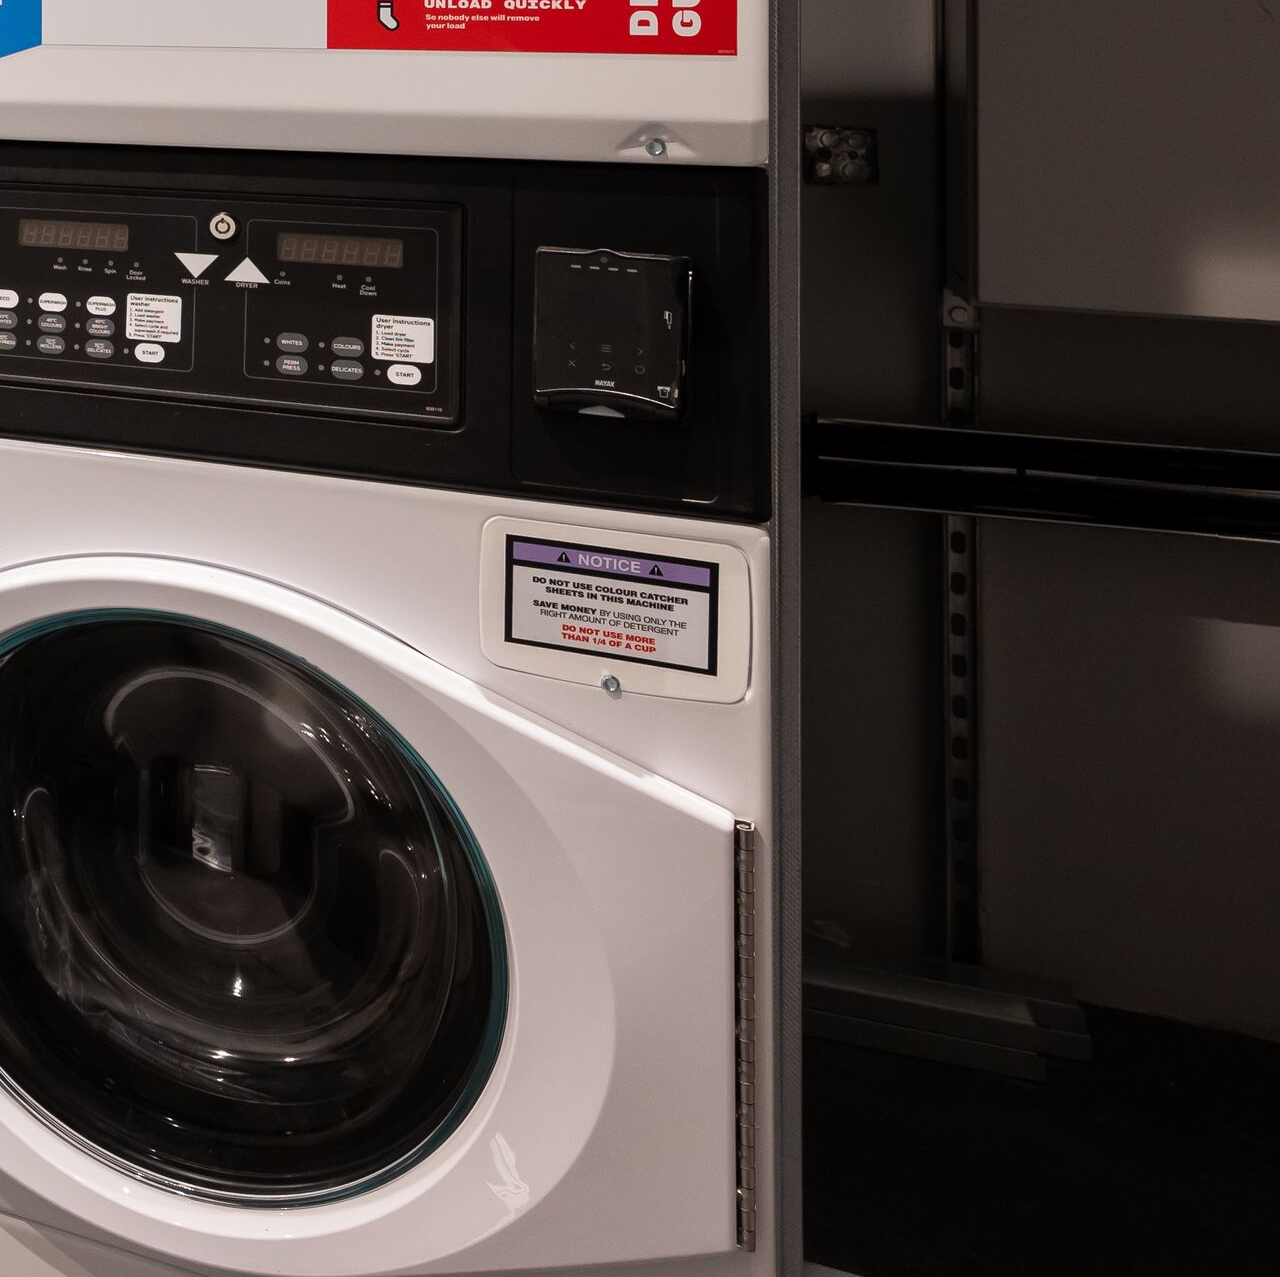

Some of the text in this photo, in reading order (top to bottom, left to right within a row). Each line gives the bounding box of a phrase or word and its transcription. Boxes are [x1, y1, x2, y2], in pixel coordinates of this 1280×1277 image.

[424, 0, 586, 9] UNLOAD QUICKLY
[594, 379, 614, 387] NAYAX
[578, 553, 640, 573] NOTICE
[532, 576, 689, 605] DO NOT USE COLOUR CATCHER
[545, 586, 675, 612] SHEETS IN THIS MACHINE
[532, 599, 687, 630] SAVE MONEY BY USING ONLY THE
[540, 608, 680, 637] RIGHT AMOUNT OF DETERGENT
[561, 624, 656, 645] DO NOT USE MORE
[561, 632, 590, 643] THAN
[592, 637, 607, 646] 1/4
[608, 639, 623, 648] OF
[634, 644, 656, 654] CUP
